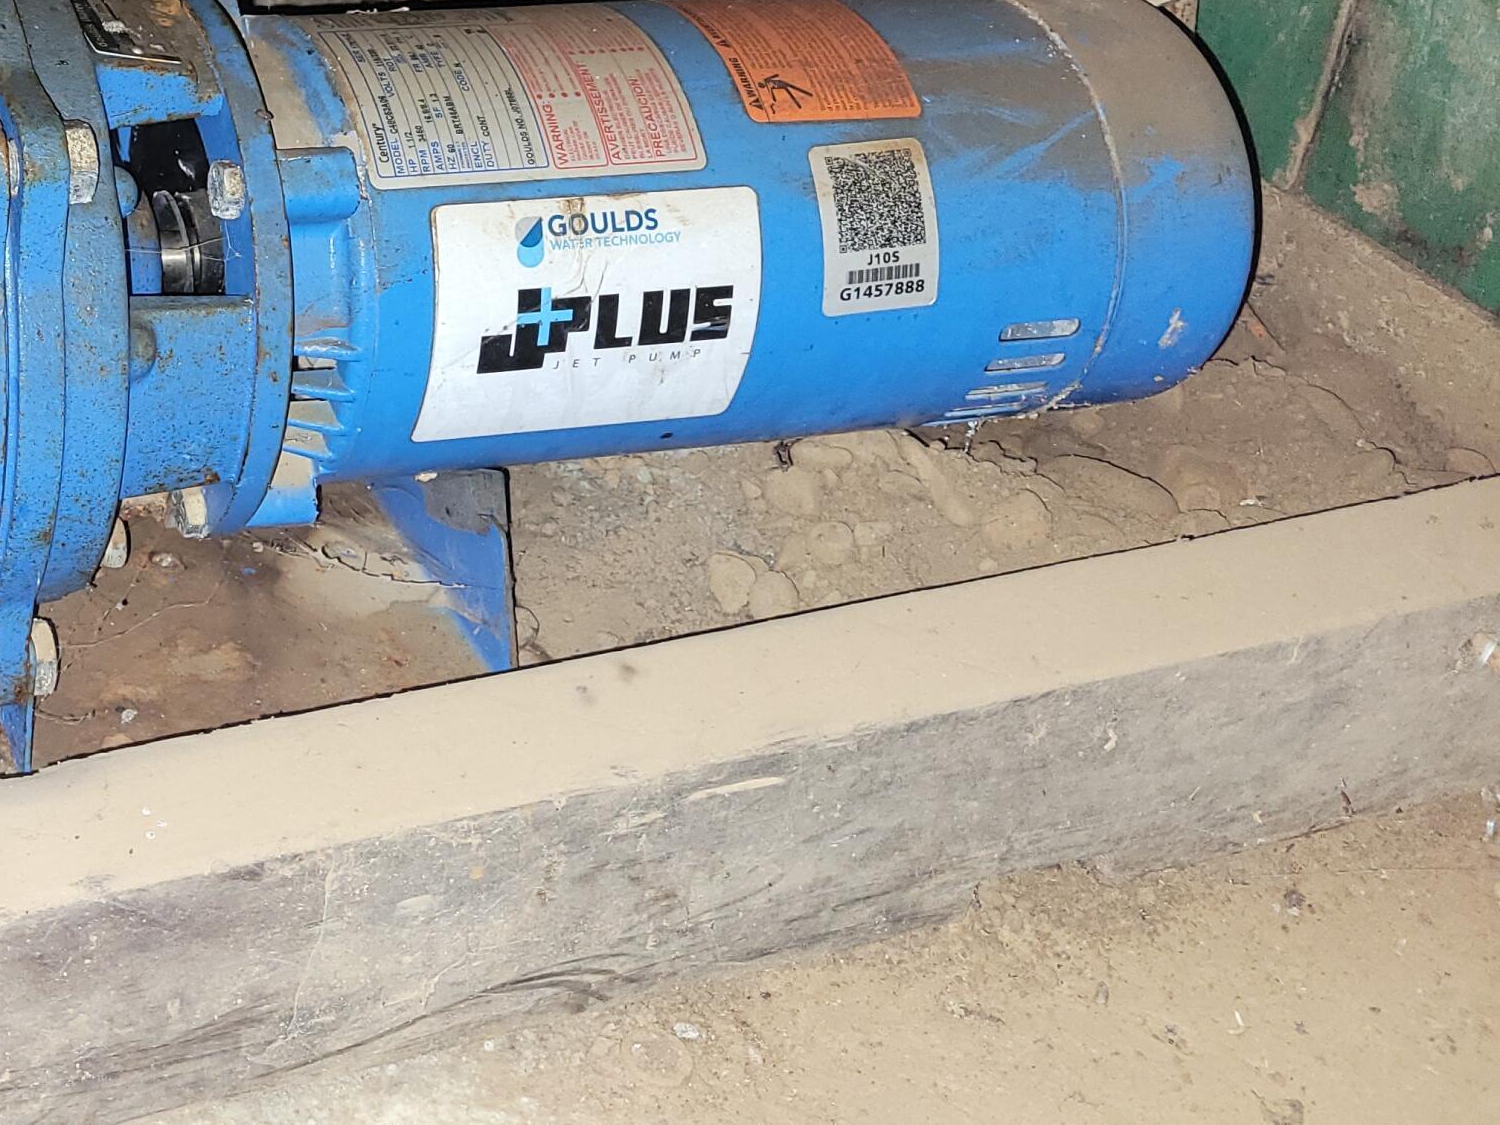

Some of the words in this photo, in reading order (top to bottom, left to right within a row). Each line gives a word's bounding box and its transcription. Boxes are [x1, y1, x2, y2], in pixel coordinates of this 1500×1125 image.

[383, 58, 397, 72] ROT
[378, 71, 395, 97] VOLTS
[454, 70, 469, 92] CODE
[728, 57, 756, 99] WARNING
[432, 106, 443, 119] SF
[476, 115, 490, 137] CONT
[542, 100, 569, 166] WARNING:
[391, 138, 405, 174] MODEL
[431, 140, 446, 171] AMPS
[447, 143, 456, 154] 60
[470, 141, 482, 168] ENCL
[481, 140, 495, 168] DUTY
[520, 131, 535, 165] GOULDS
[408, 158, 418, 173] HP
[419, 149, 431, 173] RPM
[447, 156, 457, 171] HZ
[549, 208, 659, 237] GOULDS
[550, 237, 593, 251] WATER
[595, 231, 681, 247] TECHNOLOGY
[867, 250, 900, 266] J10S
[840, 279, 925, 301] G1457888
[553, 356, 601, 370] JET
[628, 348, 702, 364] PUMP
